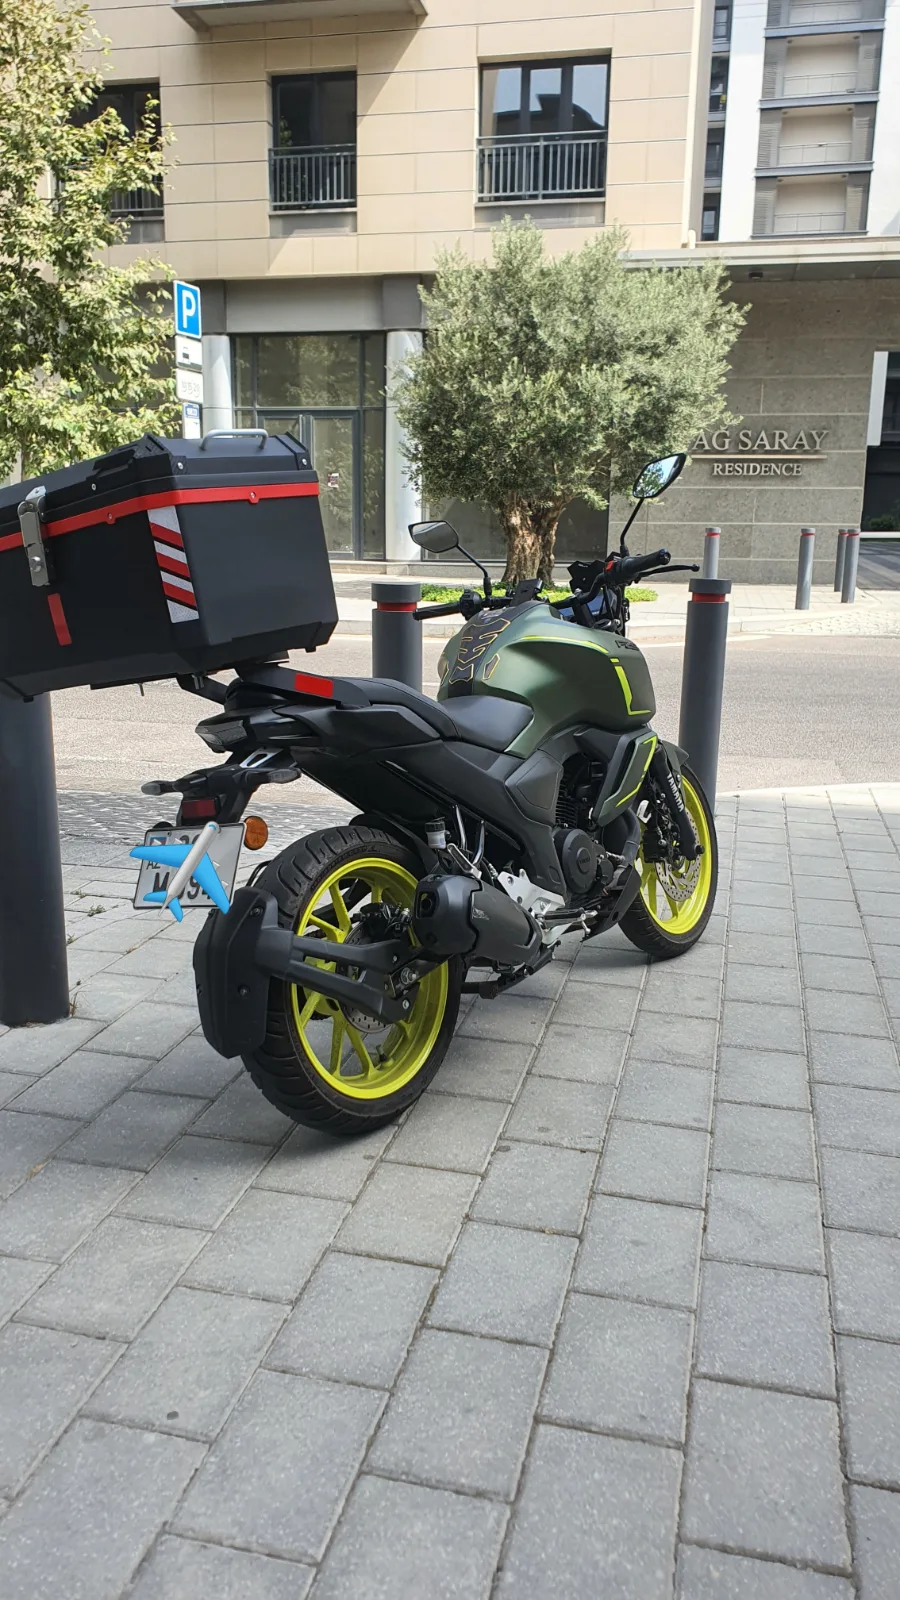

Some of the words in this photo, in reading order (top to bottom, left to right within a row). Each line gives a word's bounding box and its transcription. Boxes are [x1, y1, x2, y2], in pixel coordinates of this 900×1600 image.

[182, 289, 196, 329] P
[738, 429, 829, 450] SARAY
[711, 463, 803, 476] RESIDENCE
